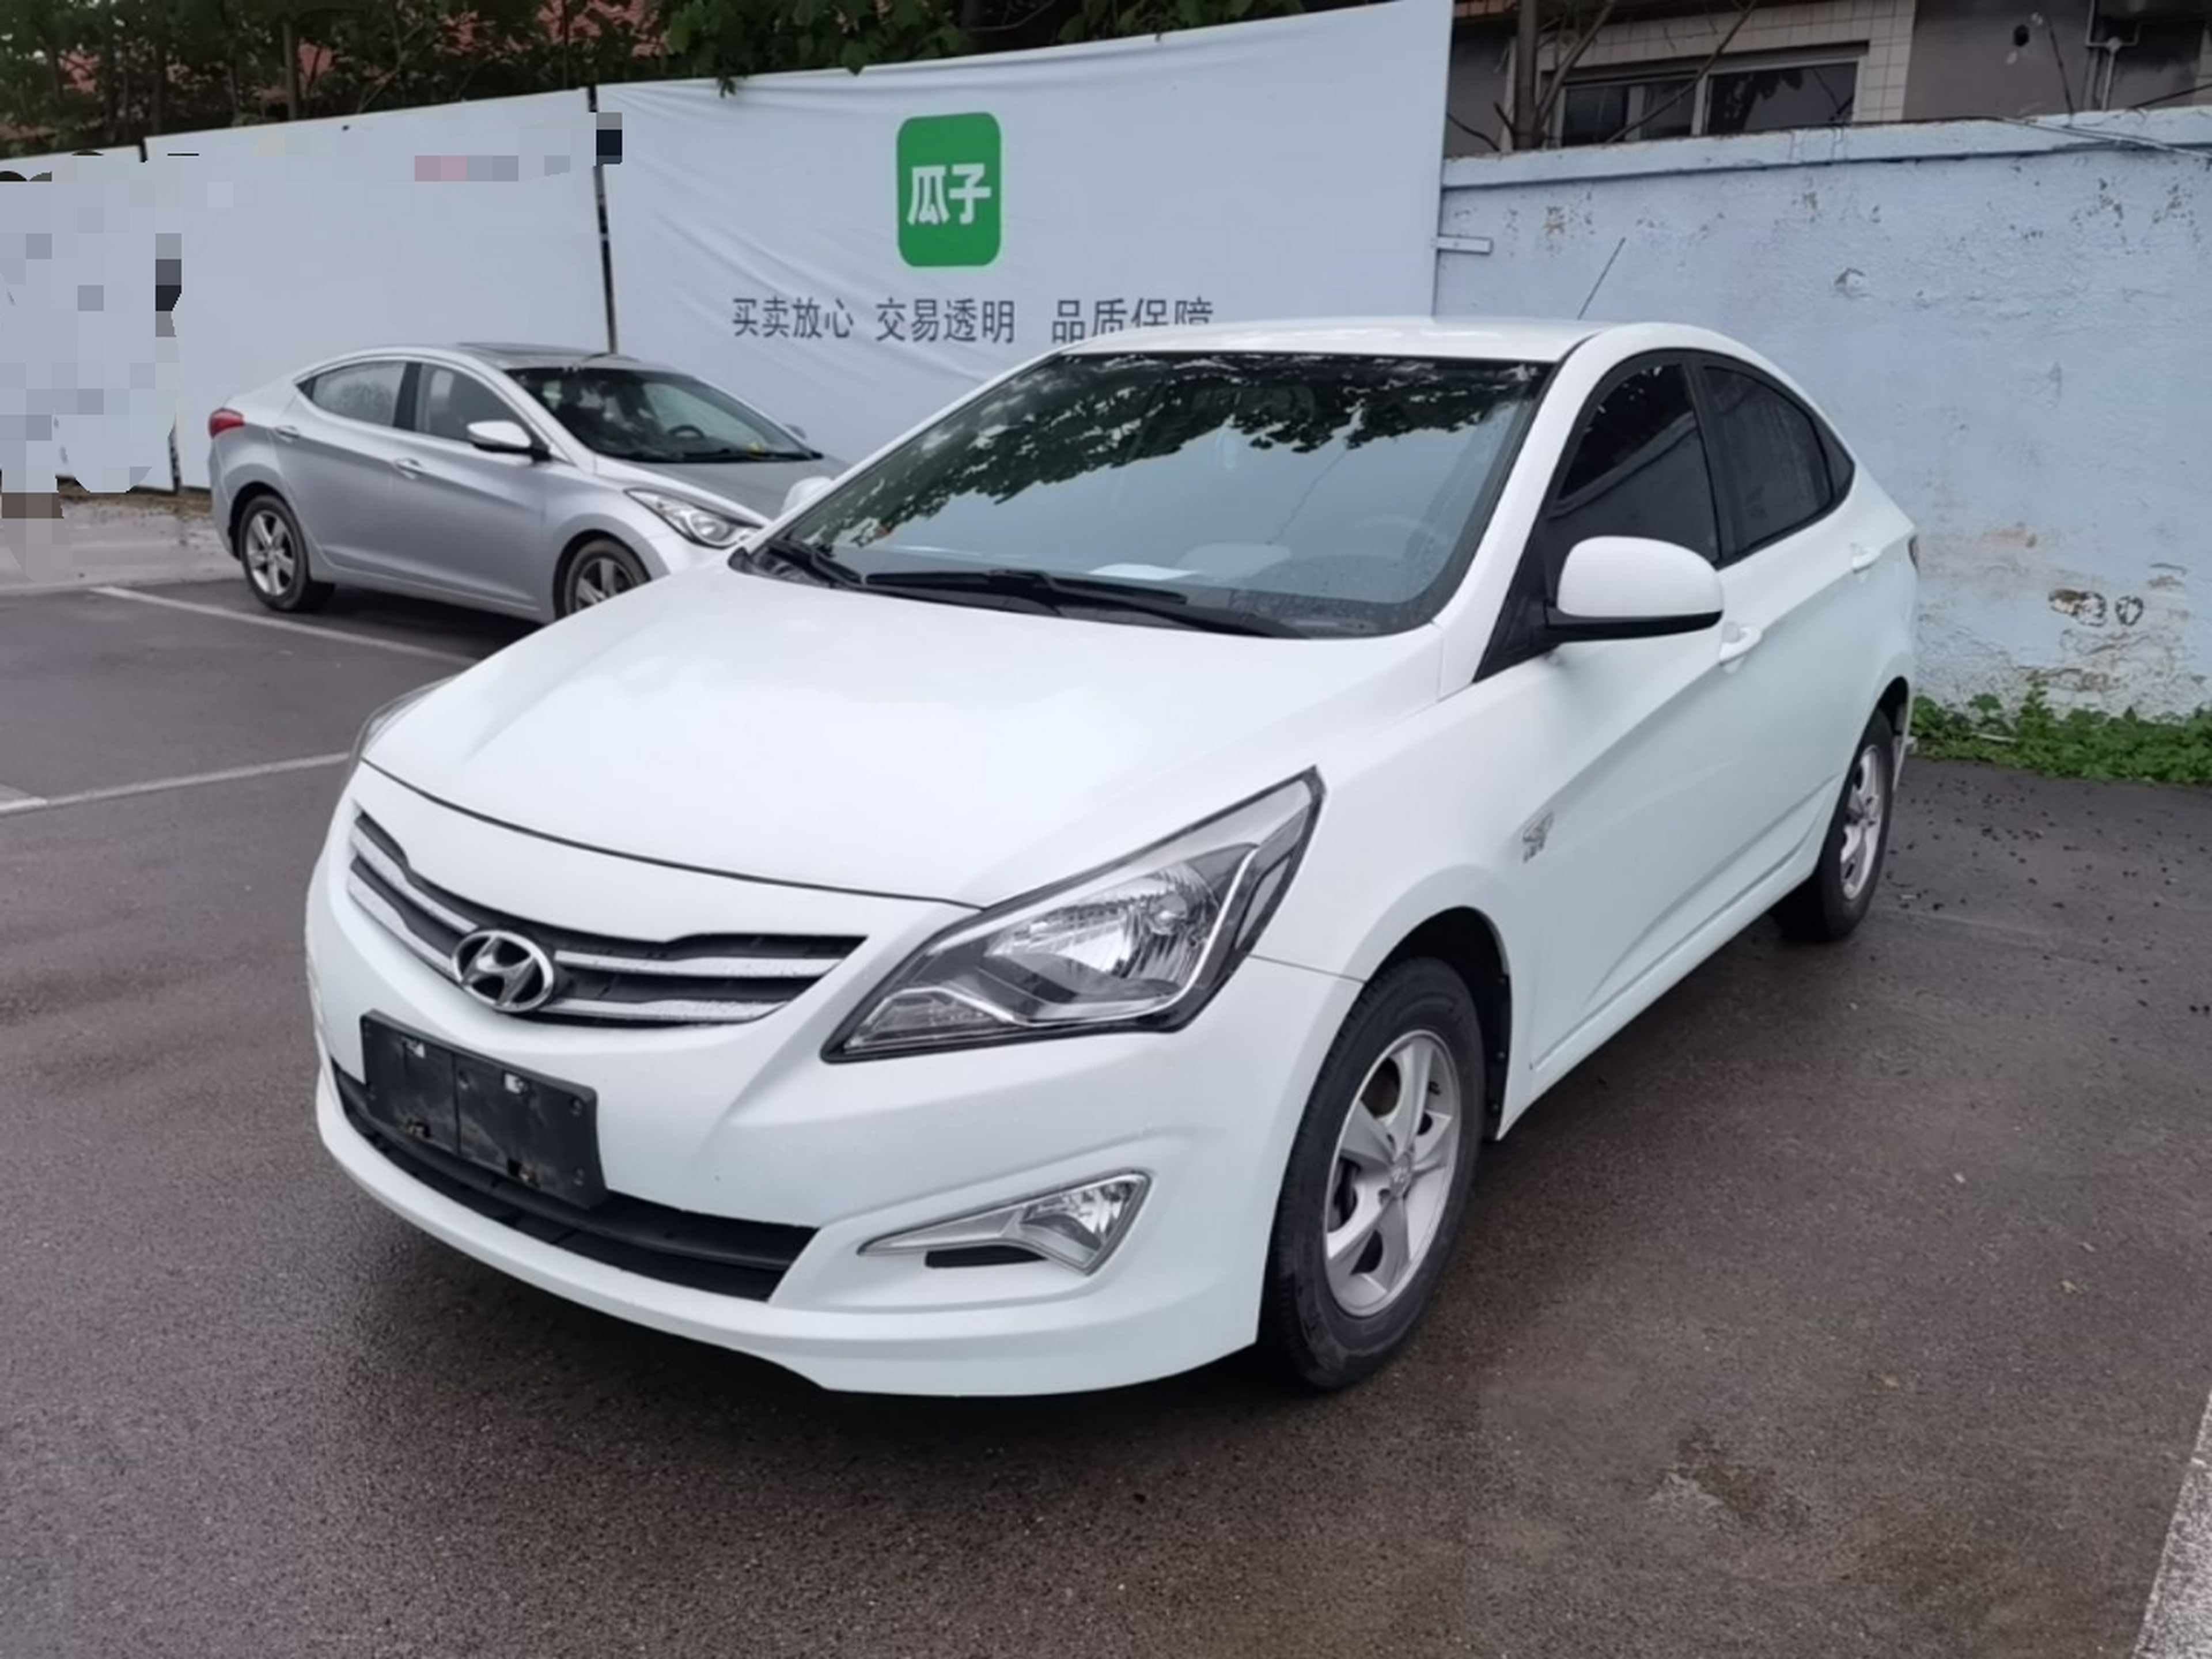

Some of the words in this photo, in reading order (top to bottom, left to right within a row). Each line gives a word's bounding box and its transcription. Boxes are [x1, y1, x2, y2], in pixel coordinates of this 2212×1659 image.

[907, 162, 992, 226] 瓜子
[732, 296, 854, 339] 买卖放心
[875, 297, 1016, 344] 交易透明
